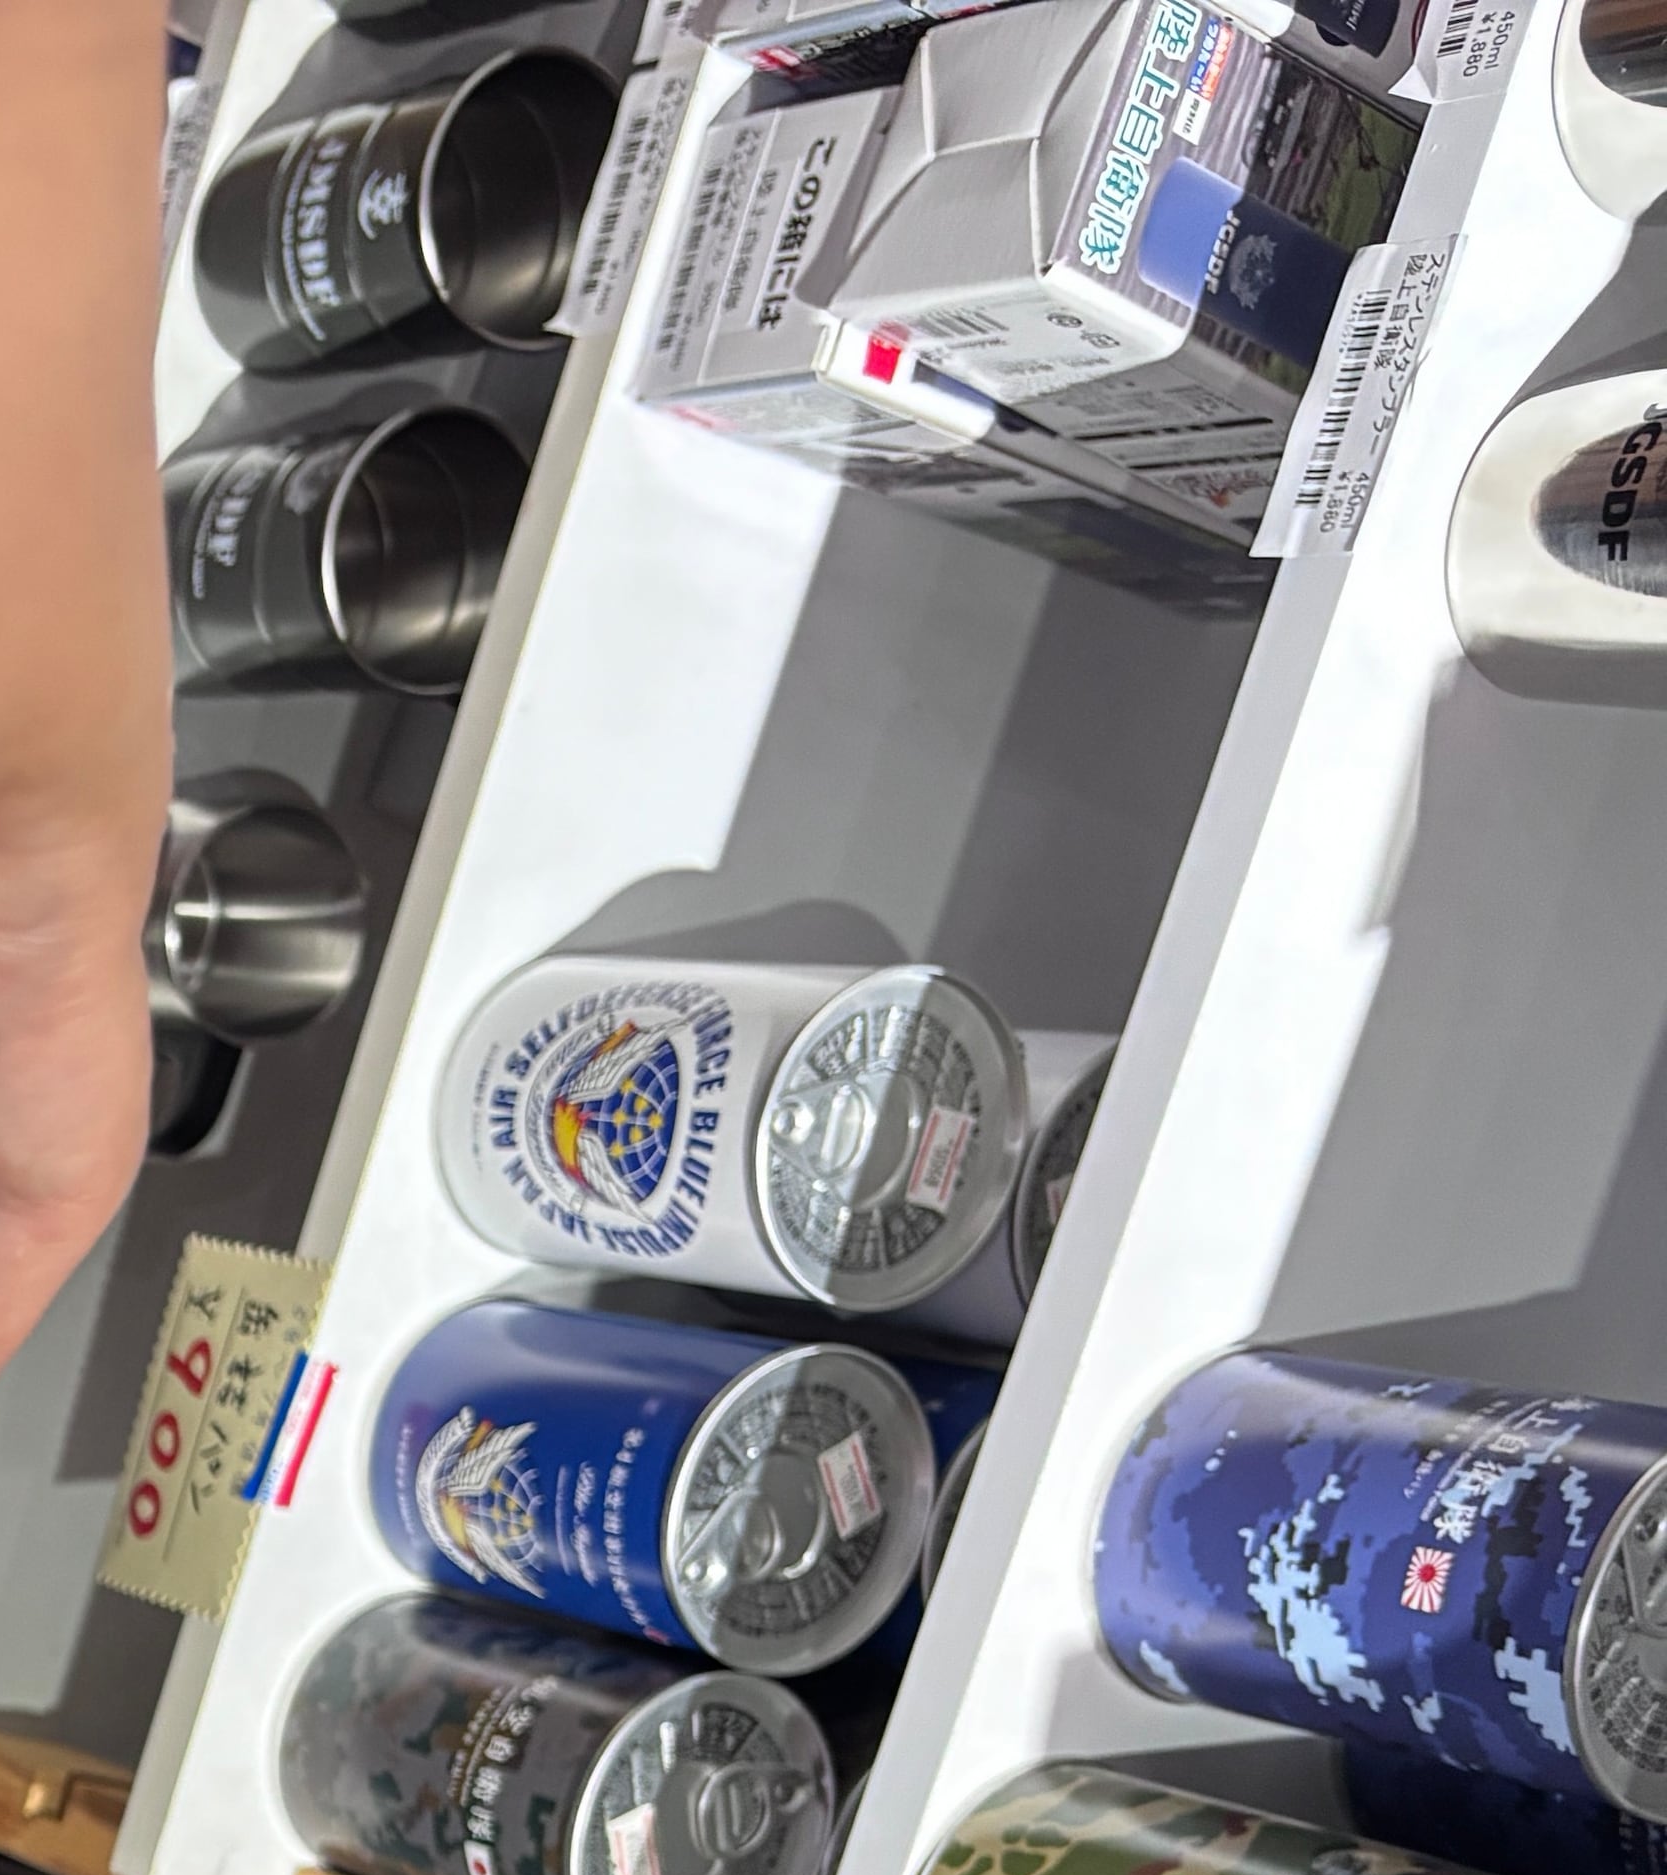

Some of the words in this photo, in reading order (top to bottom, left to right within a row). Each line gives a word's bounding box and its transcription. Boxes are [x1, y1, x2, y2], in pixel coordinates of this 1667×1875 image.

[1462, 12, 1496, 76] ¥1,880
[1483, 12, 1516, 70] 450ml
[1075, 0, 1201, 273] 陸上自衛隊
[753, 138, 838, 336] この箱には
[1200, 209, 1242, 295] JGSDF
[1606, 404, 1667, 560] JGSDF
[687, 1106, 722, 1208] BLUE
